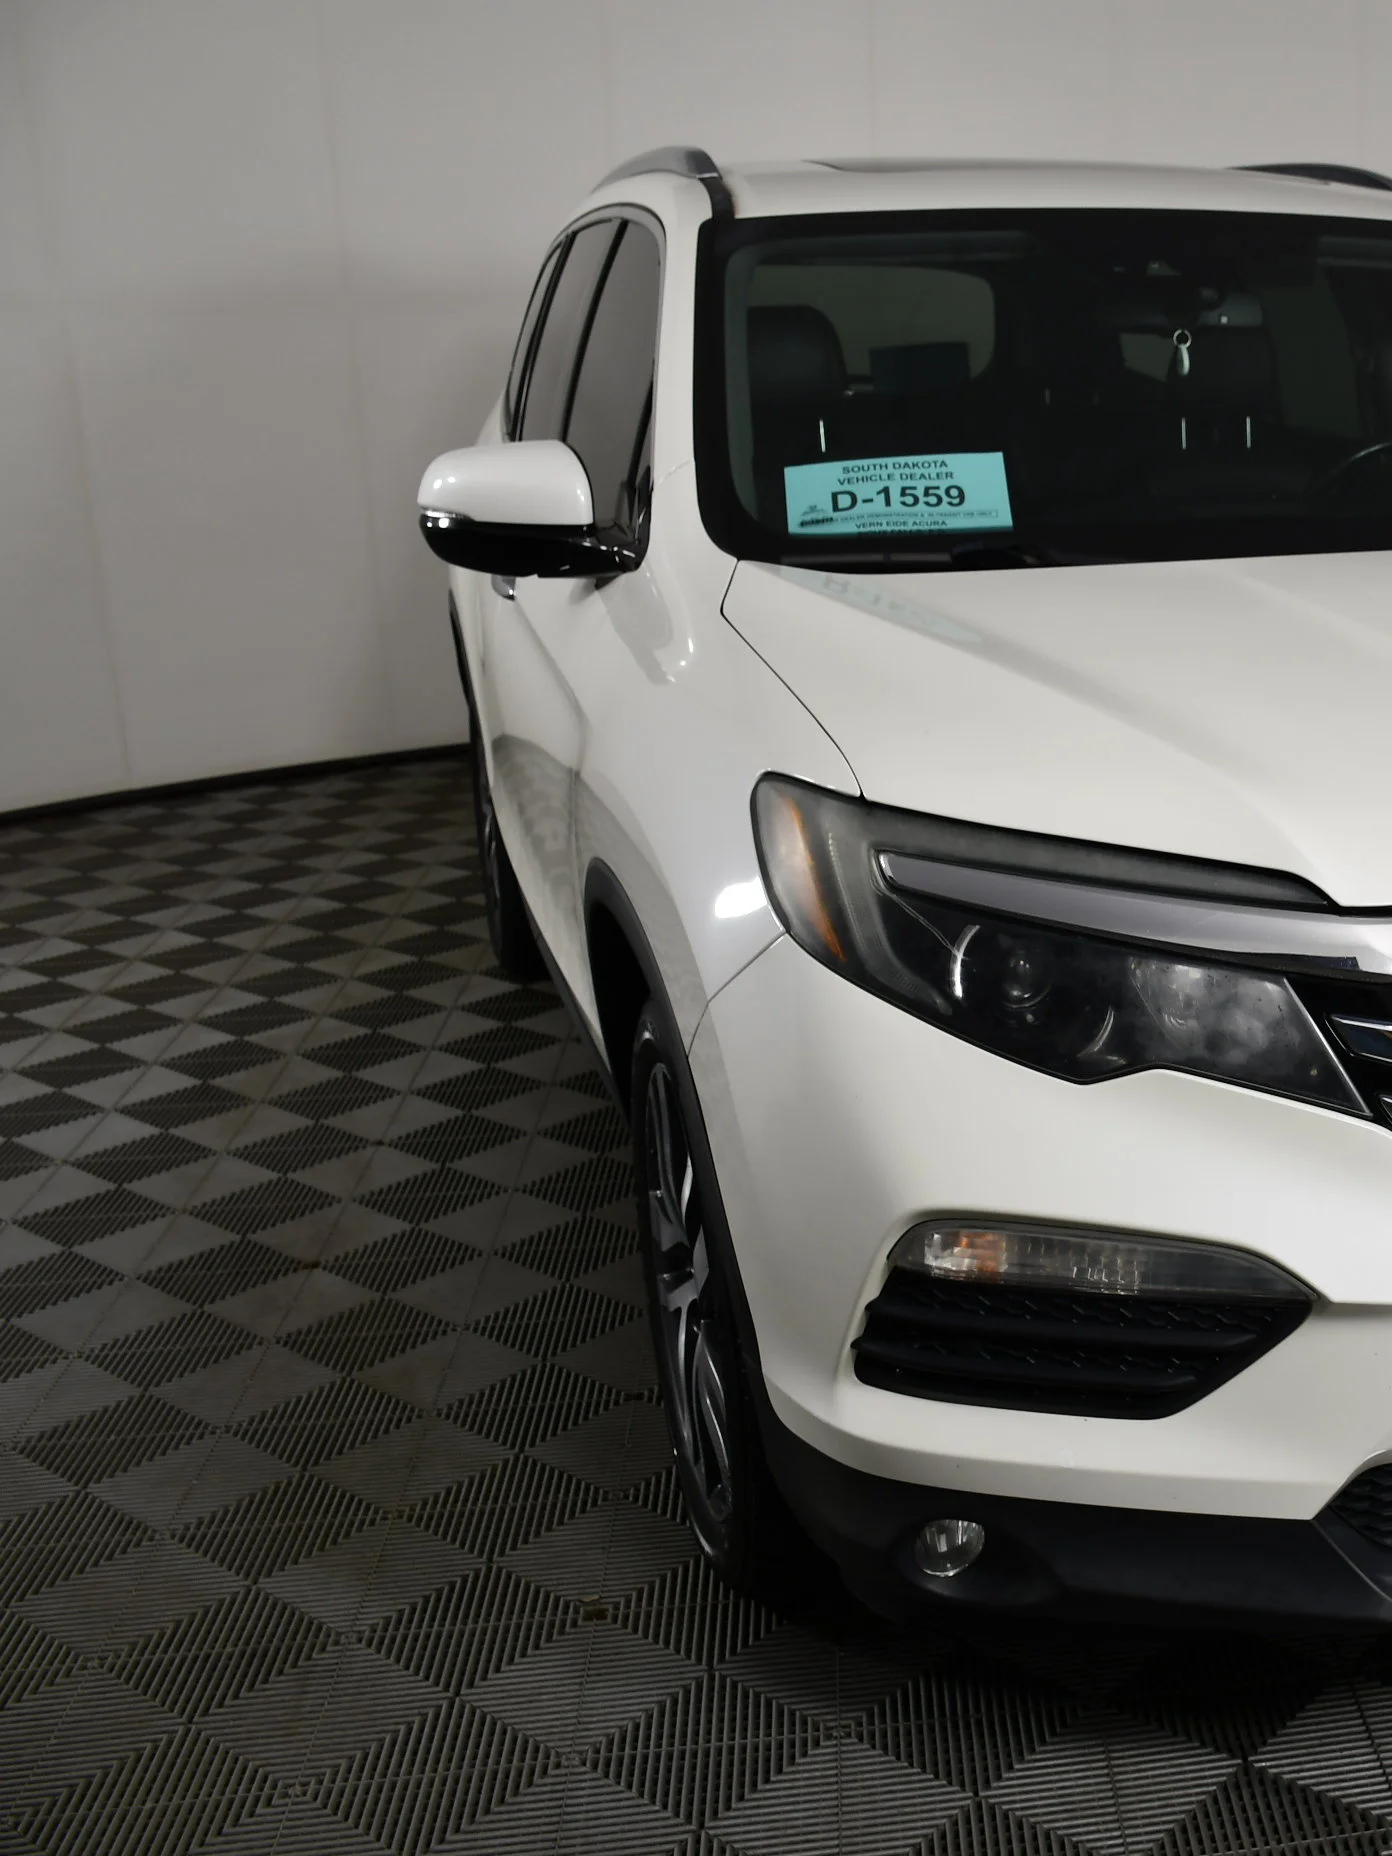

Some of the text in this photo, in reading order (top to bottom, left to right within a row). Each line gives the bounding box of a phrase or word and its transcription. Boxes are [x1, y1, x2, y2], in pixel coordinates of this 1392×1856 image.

[842, 460, 949, 474] SOUTH DAKOTA
[837, 471, 955, 486] VEHICLE DEALER
[830, 485, 966, 513] D-1559
[855, 519, 948, 529] VERN EIDE ACURA
